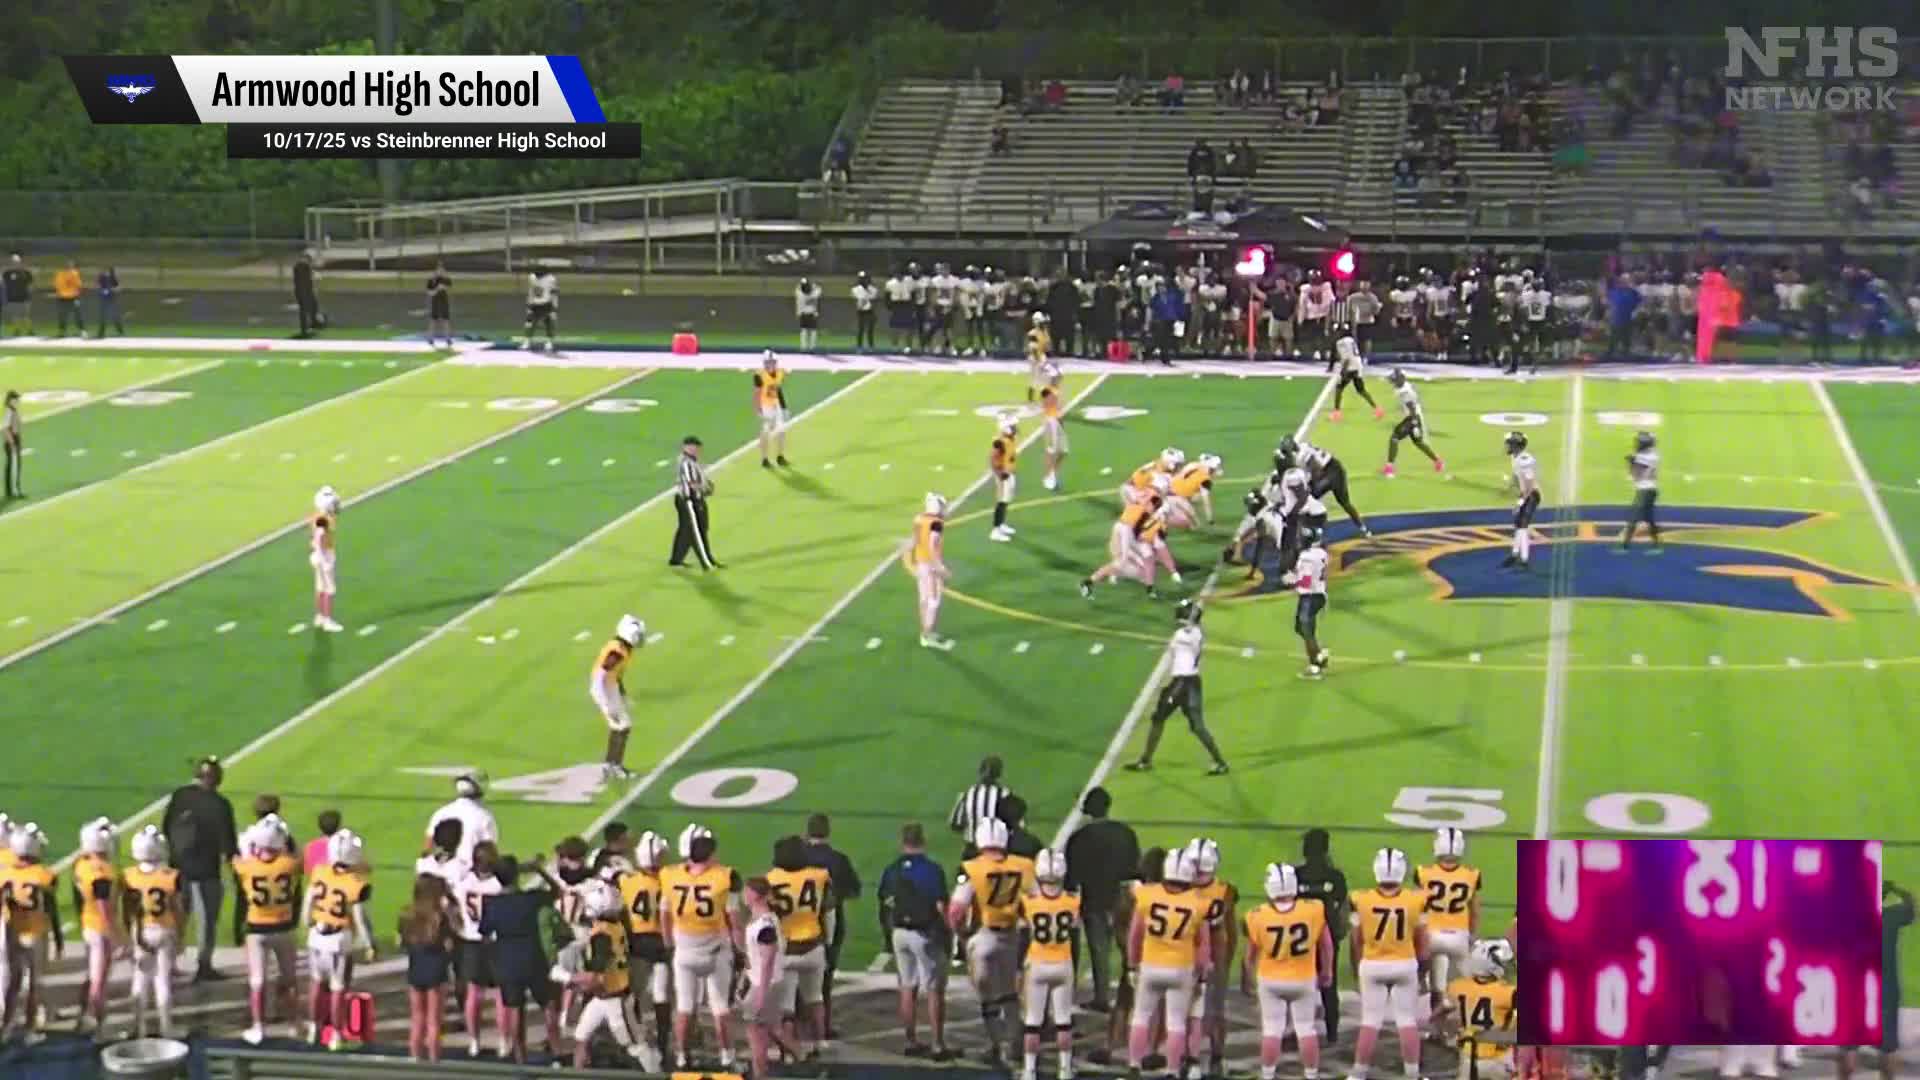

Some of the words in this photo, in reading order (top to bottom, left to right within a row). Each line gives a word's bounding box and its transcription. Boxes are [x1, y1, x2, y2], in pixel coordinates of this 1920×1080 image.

[489, 763, 799, 807] 40
[1384, 786, 1711, 833] 50
[252, 873, 291, 906] 53
[314, 879, 347, 918] 23
[673, 884, 715, 917] 75
[768, 879, 817, 917] 54
[986, 871, 1023, 905] 77
[1428, 880, 1469, 913] 22
[1032, 911, 1074, 944] 88
[1148, 903, 1193, 940] 57
[1372, 907, 1405, 941] 71
[1267, 922, 1309, 958] 72
[1458, 993, 1494, 1031] 14
